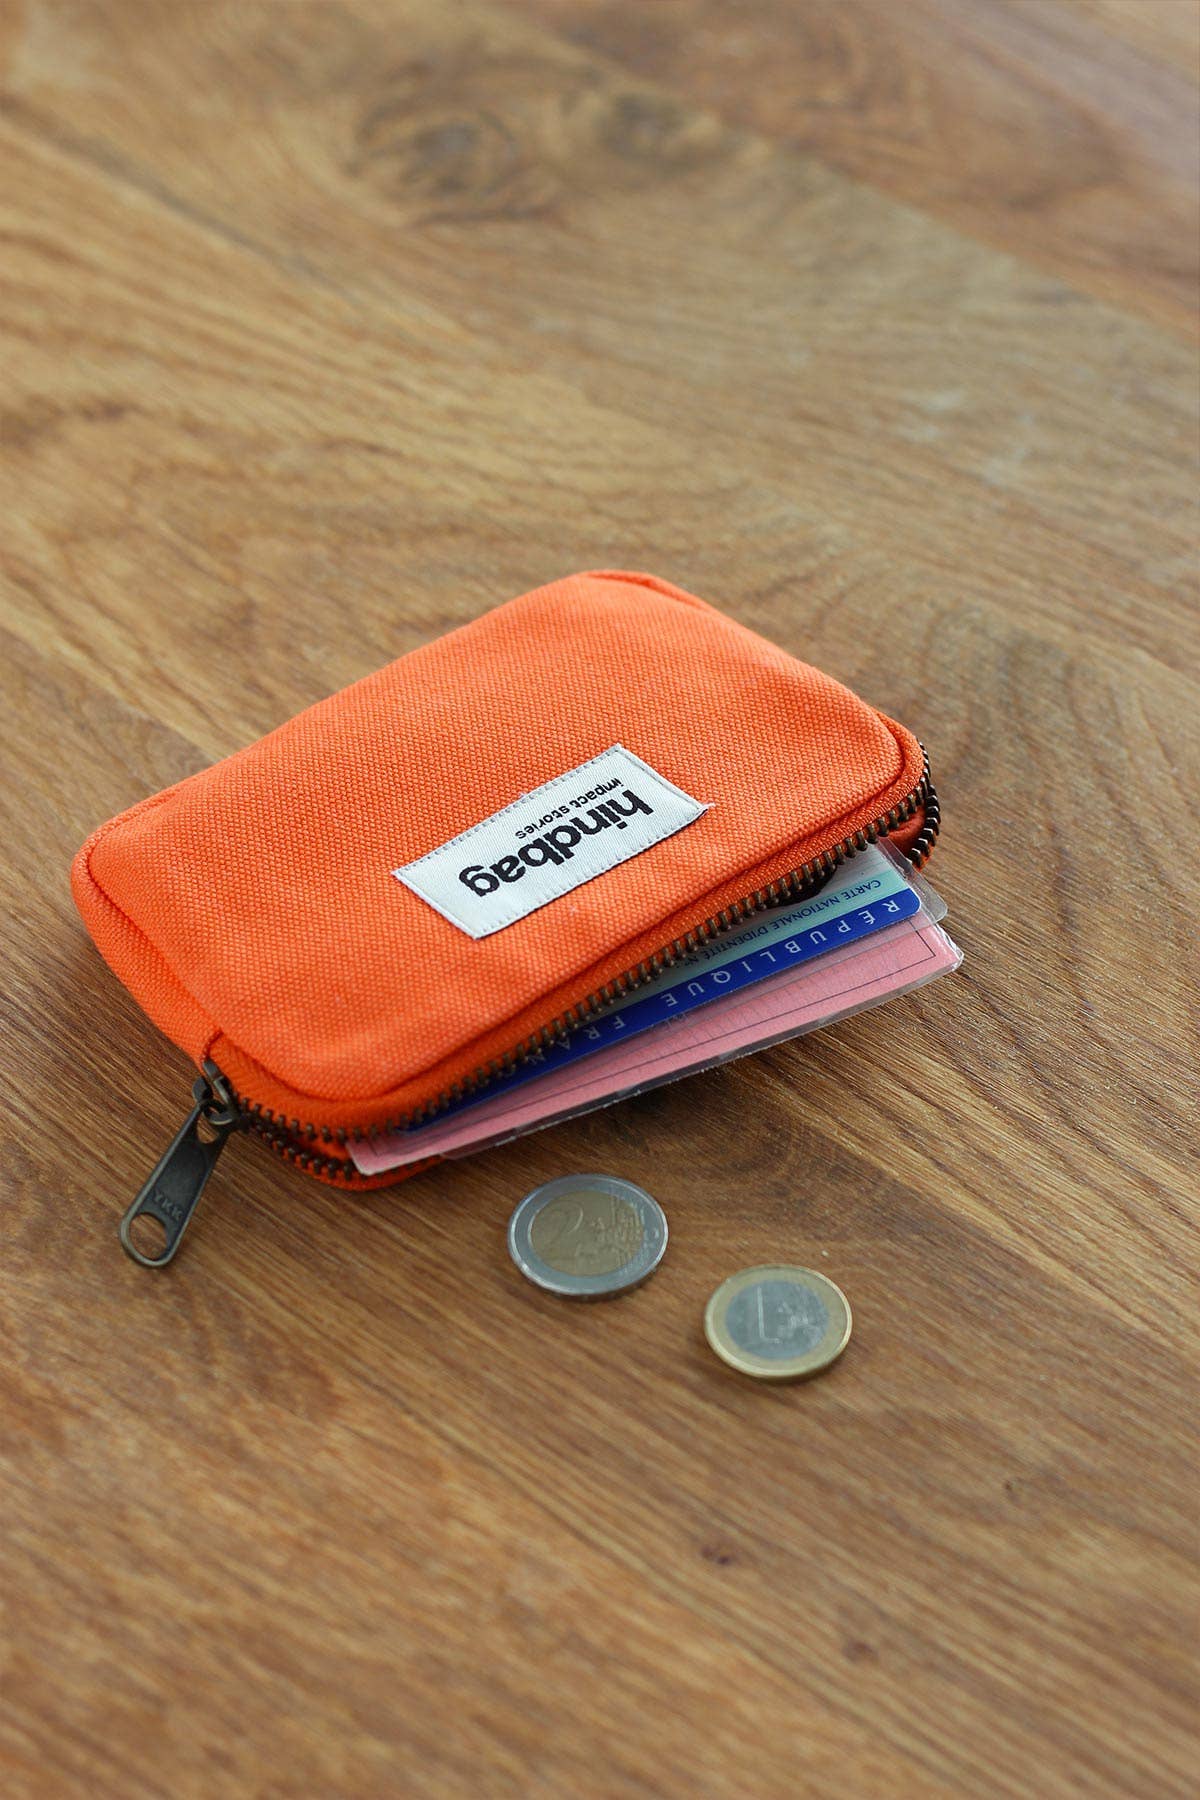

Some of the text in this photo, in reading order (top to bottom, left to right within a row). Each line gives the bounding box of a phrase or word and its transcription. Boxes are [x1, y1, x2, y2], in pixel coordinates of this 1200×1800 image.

[515, 777, 624, 839] impact stories
[458, 789, 654, 897] hindbag
[771, 895, 840, 931] NATIONALE
[843, 879, 881, 900] CARTE
[661, 900, 900, 1007] RÉPUBLIQUE
